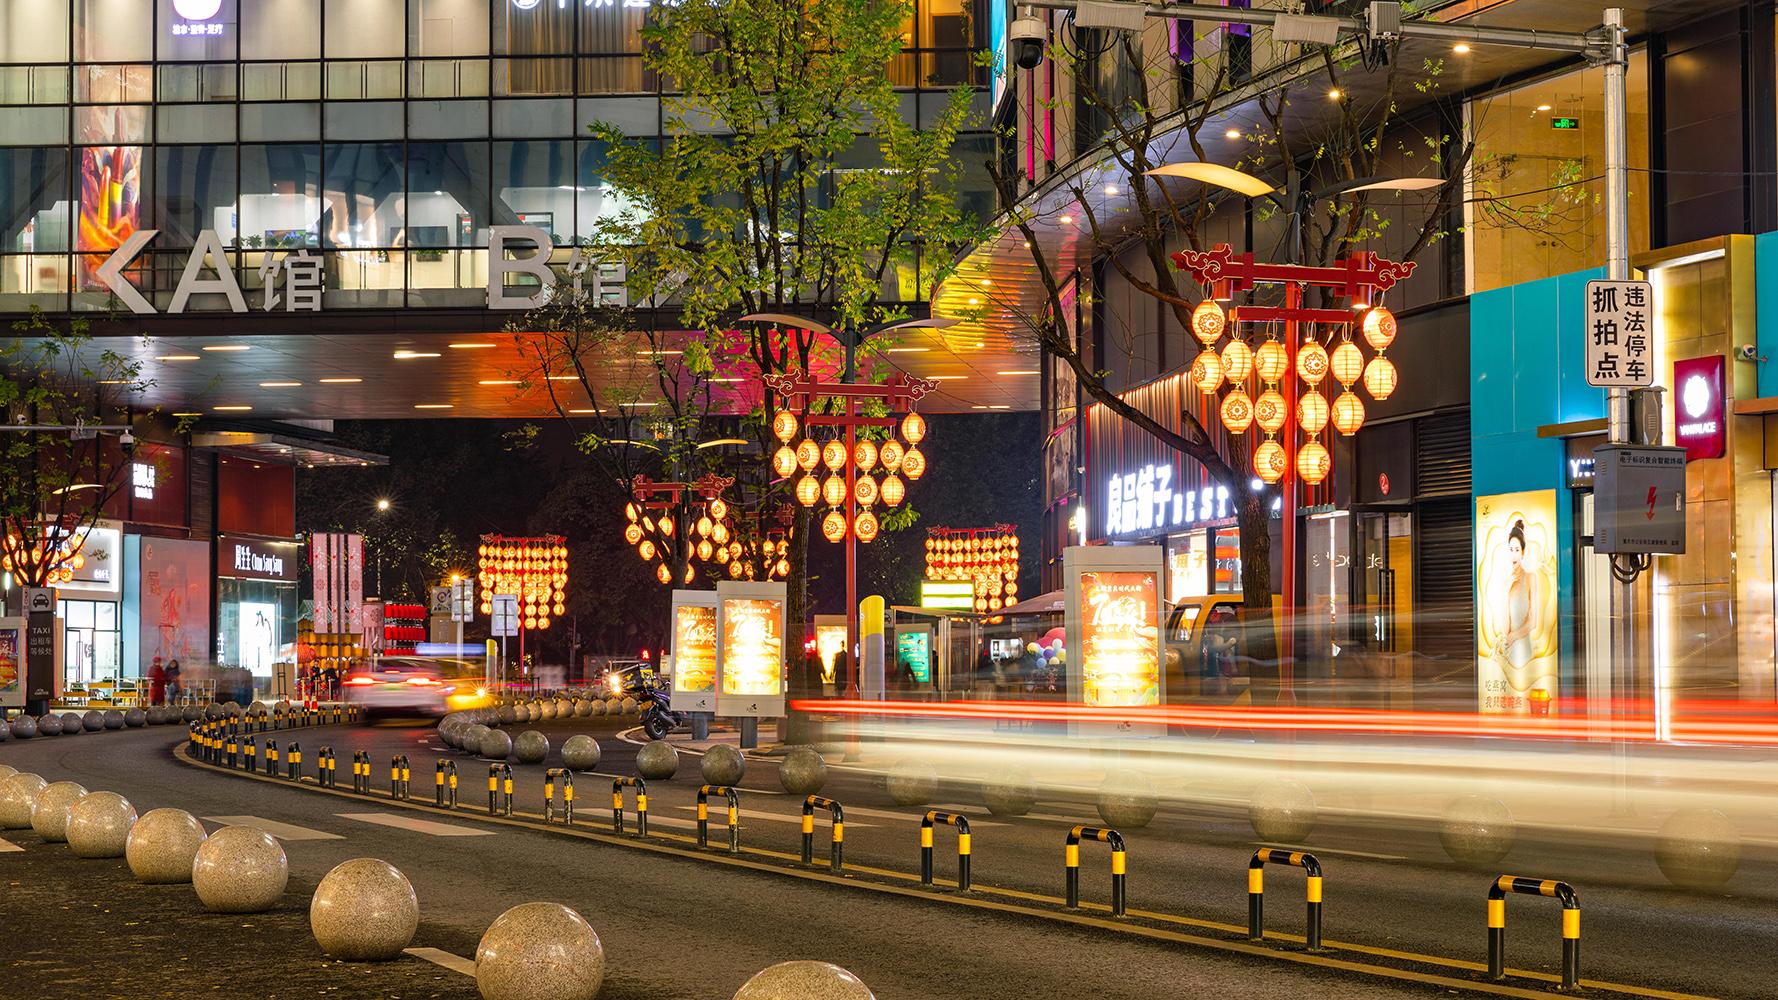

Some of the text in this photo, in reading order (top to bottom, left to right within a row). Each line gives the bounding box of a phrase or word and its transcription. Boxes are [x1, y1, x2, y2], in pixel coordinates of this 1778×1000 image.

[167, 229, 324, 313] A馆
[1593, 286, 1619, 379] 抓拍点
[1624, 286, 1646, 381] 违法停车
[30, 637, 51, 646] 出租车
[30, 647, 52, 656] 等候处
